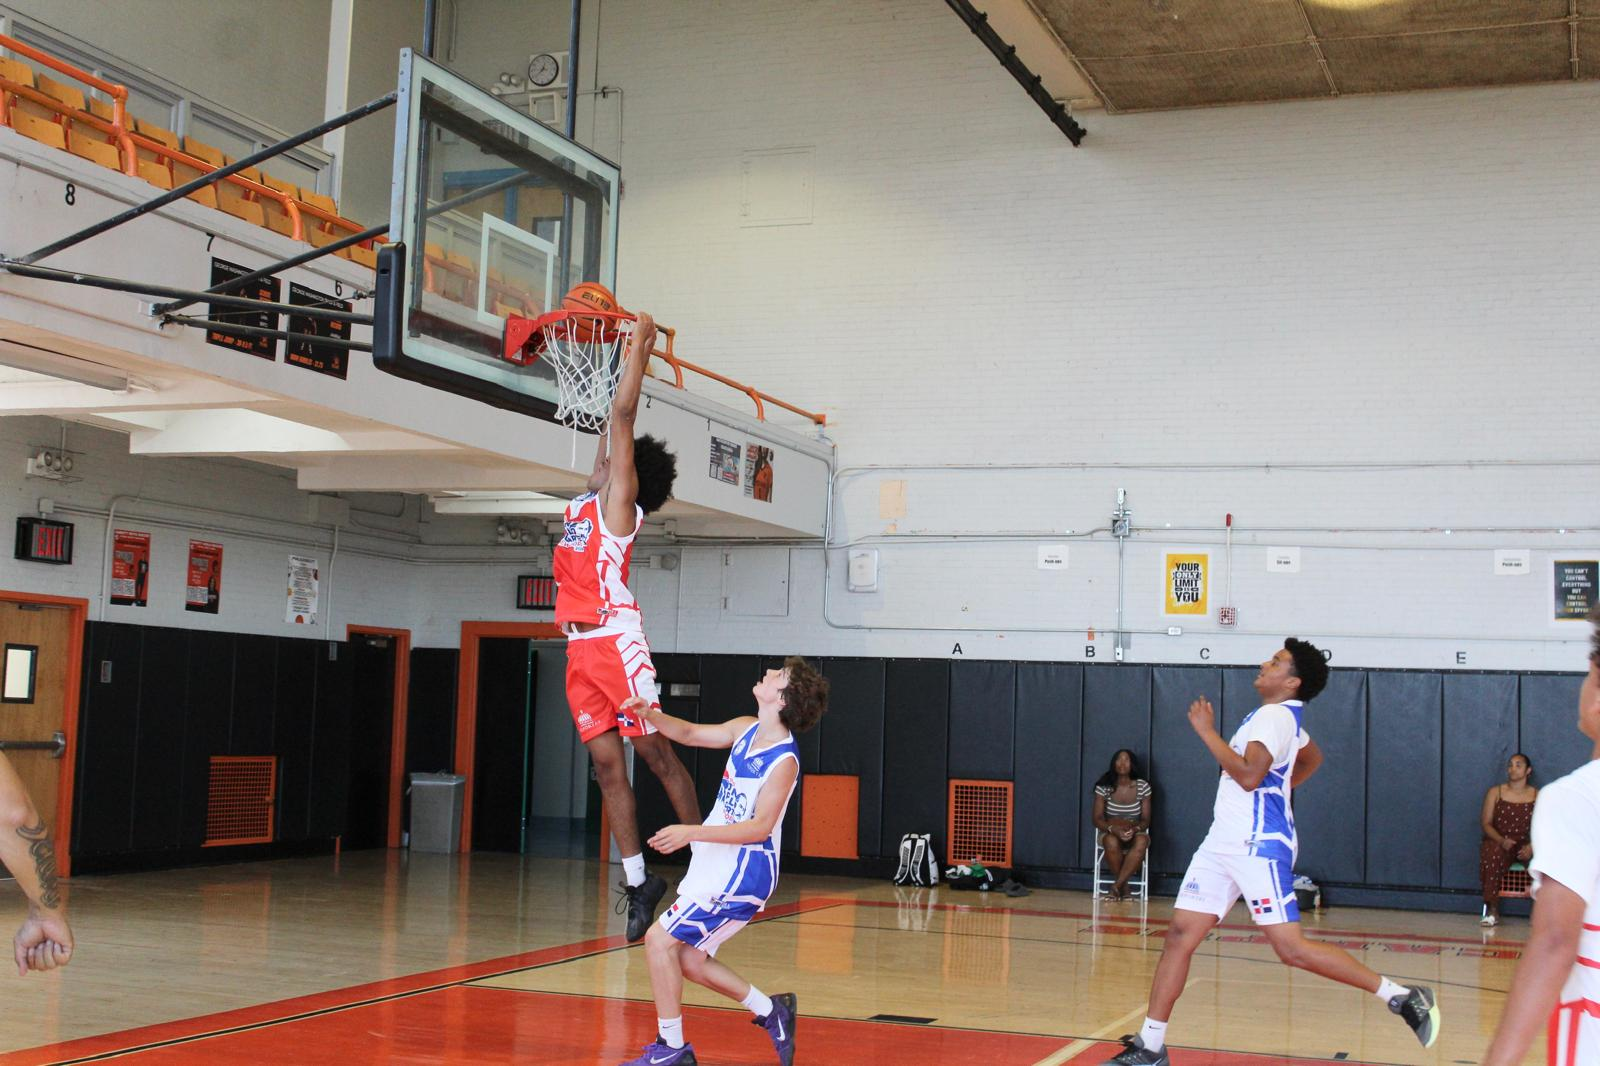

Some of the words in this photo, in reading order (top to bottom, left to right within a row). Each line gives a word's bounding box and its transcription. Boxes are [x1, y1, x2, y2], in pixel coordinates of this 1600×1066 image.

[65, 183, 76, 206] 8
[335, 280, 343, 296] 6
[582, 291, 611, 311] ELITE
[1175, 563, 1199, 571] YOUR
[1176, 571, 1198, 579] ONLY
[1175, 579, 1198, 587] LIMIT
[1175, 591, 1199, 602] YOU
[952, 642, 963, 655] A
[1085, 645, 1096, 658] B
[1199, 648, 1210, 660] C
[1455, 651, 1467, 665] E
